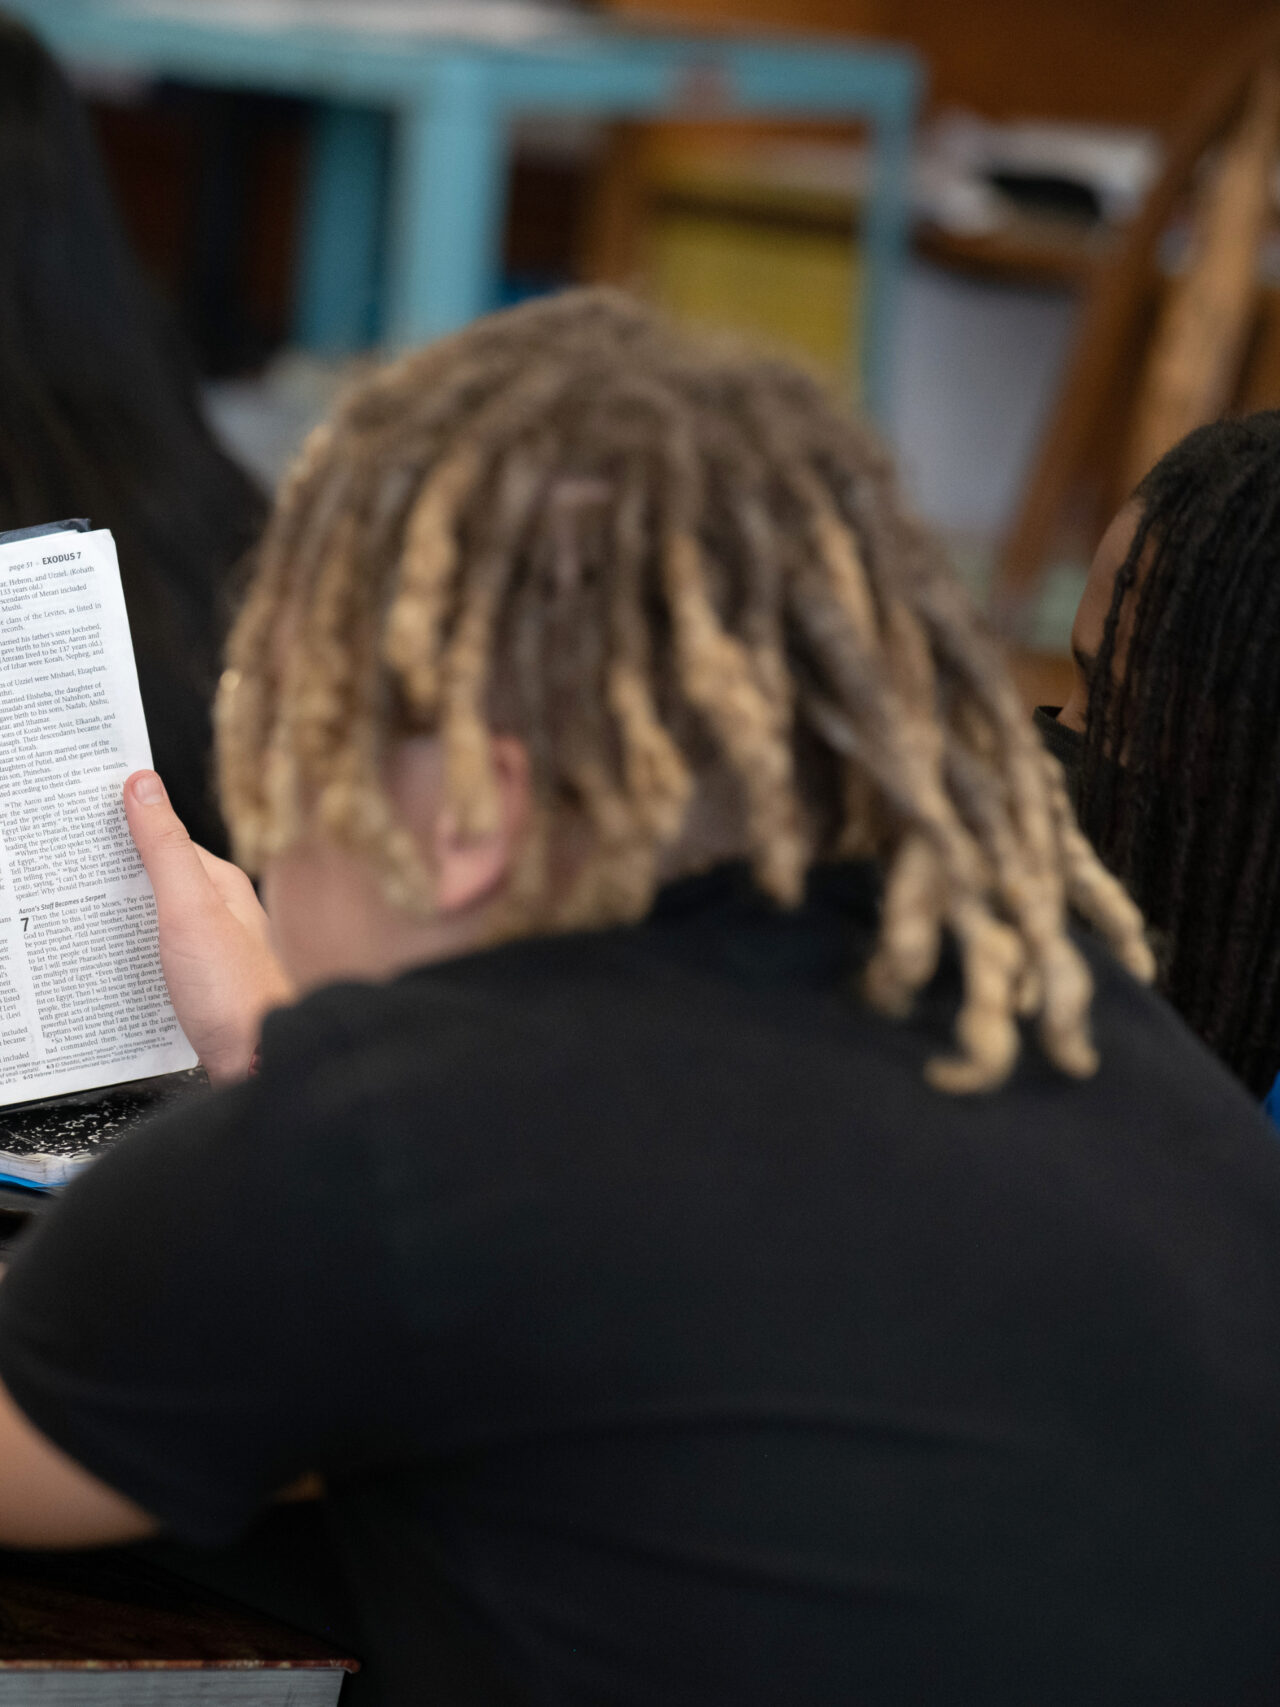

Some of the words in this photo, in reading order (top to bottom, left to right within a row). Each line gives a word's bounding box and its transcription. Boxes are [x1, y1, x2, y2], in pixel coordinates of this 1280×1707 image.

[42, 552, 75, 565] EXODUS
[9, 564, 25, 572] page
[70, 565, 94, 576] (Kohath
[39, 729, 76, 740] descendants
[77, 725, 100, 733] became
[40, 836, 59, 846] people
[68, 831, 85, 839] Israel
[18, 906, 40, 914] Aaron's
[54, 899, 79, 907] Becomes
[85, 893, 106, 902] Serpent
[20, 917, 30, 932] 7
[6, 1010, 21, 1020] (Levi
